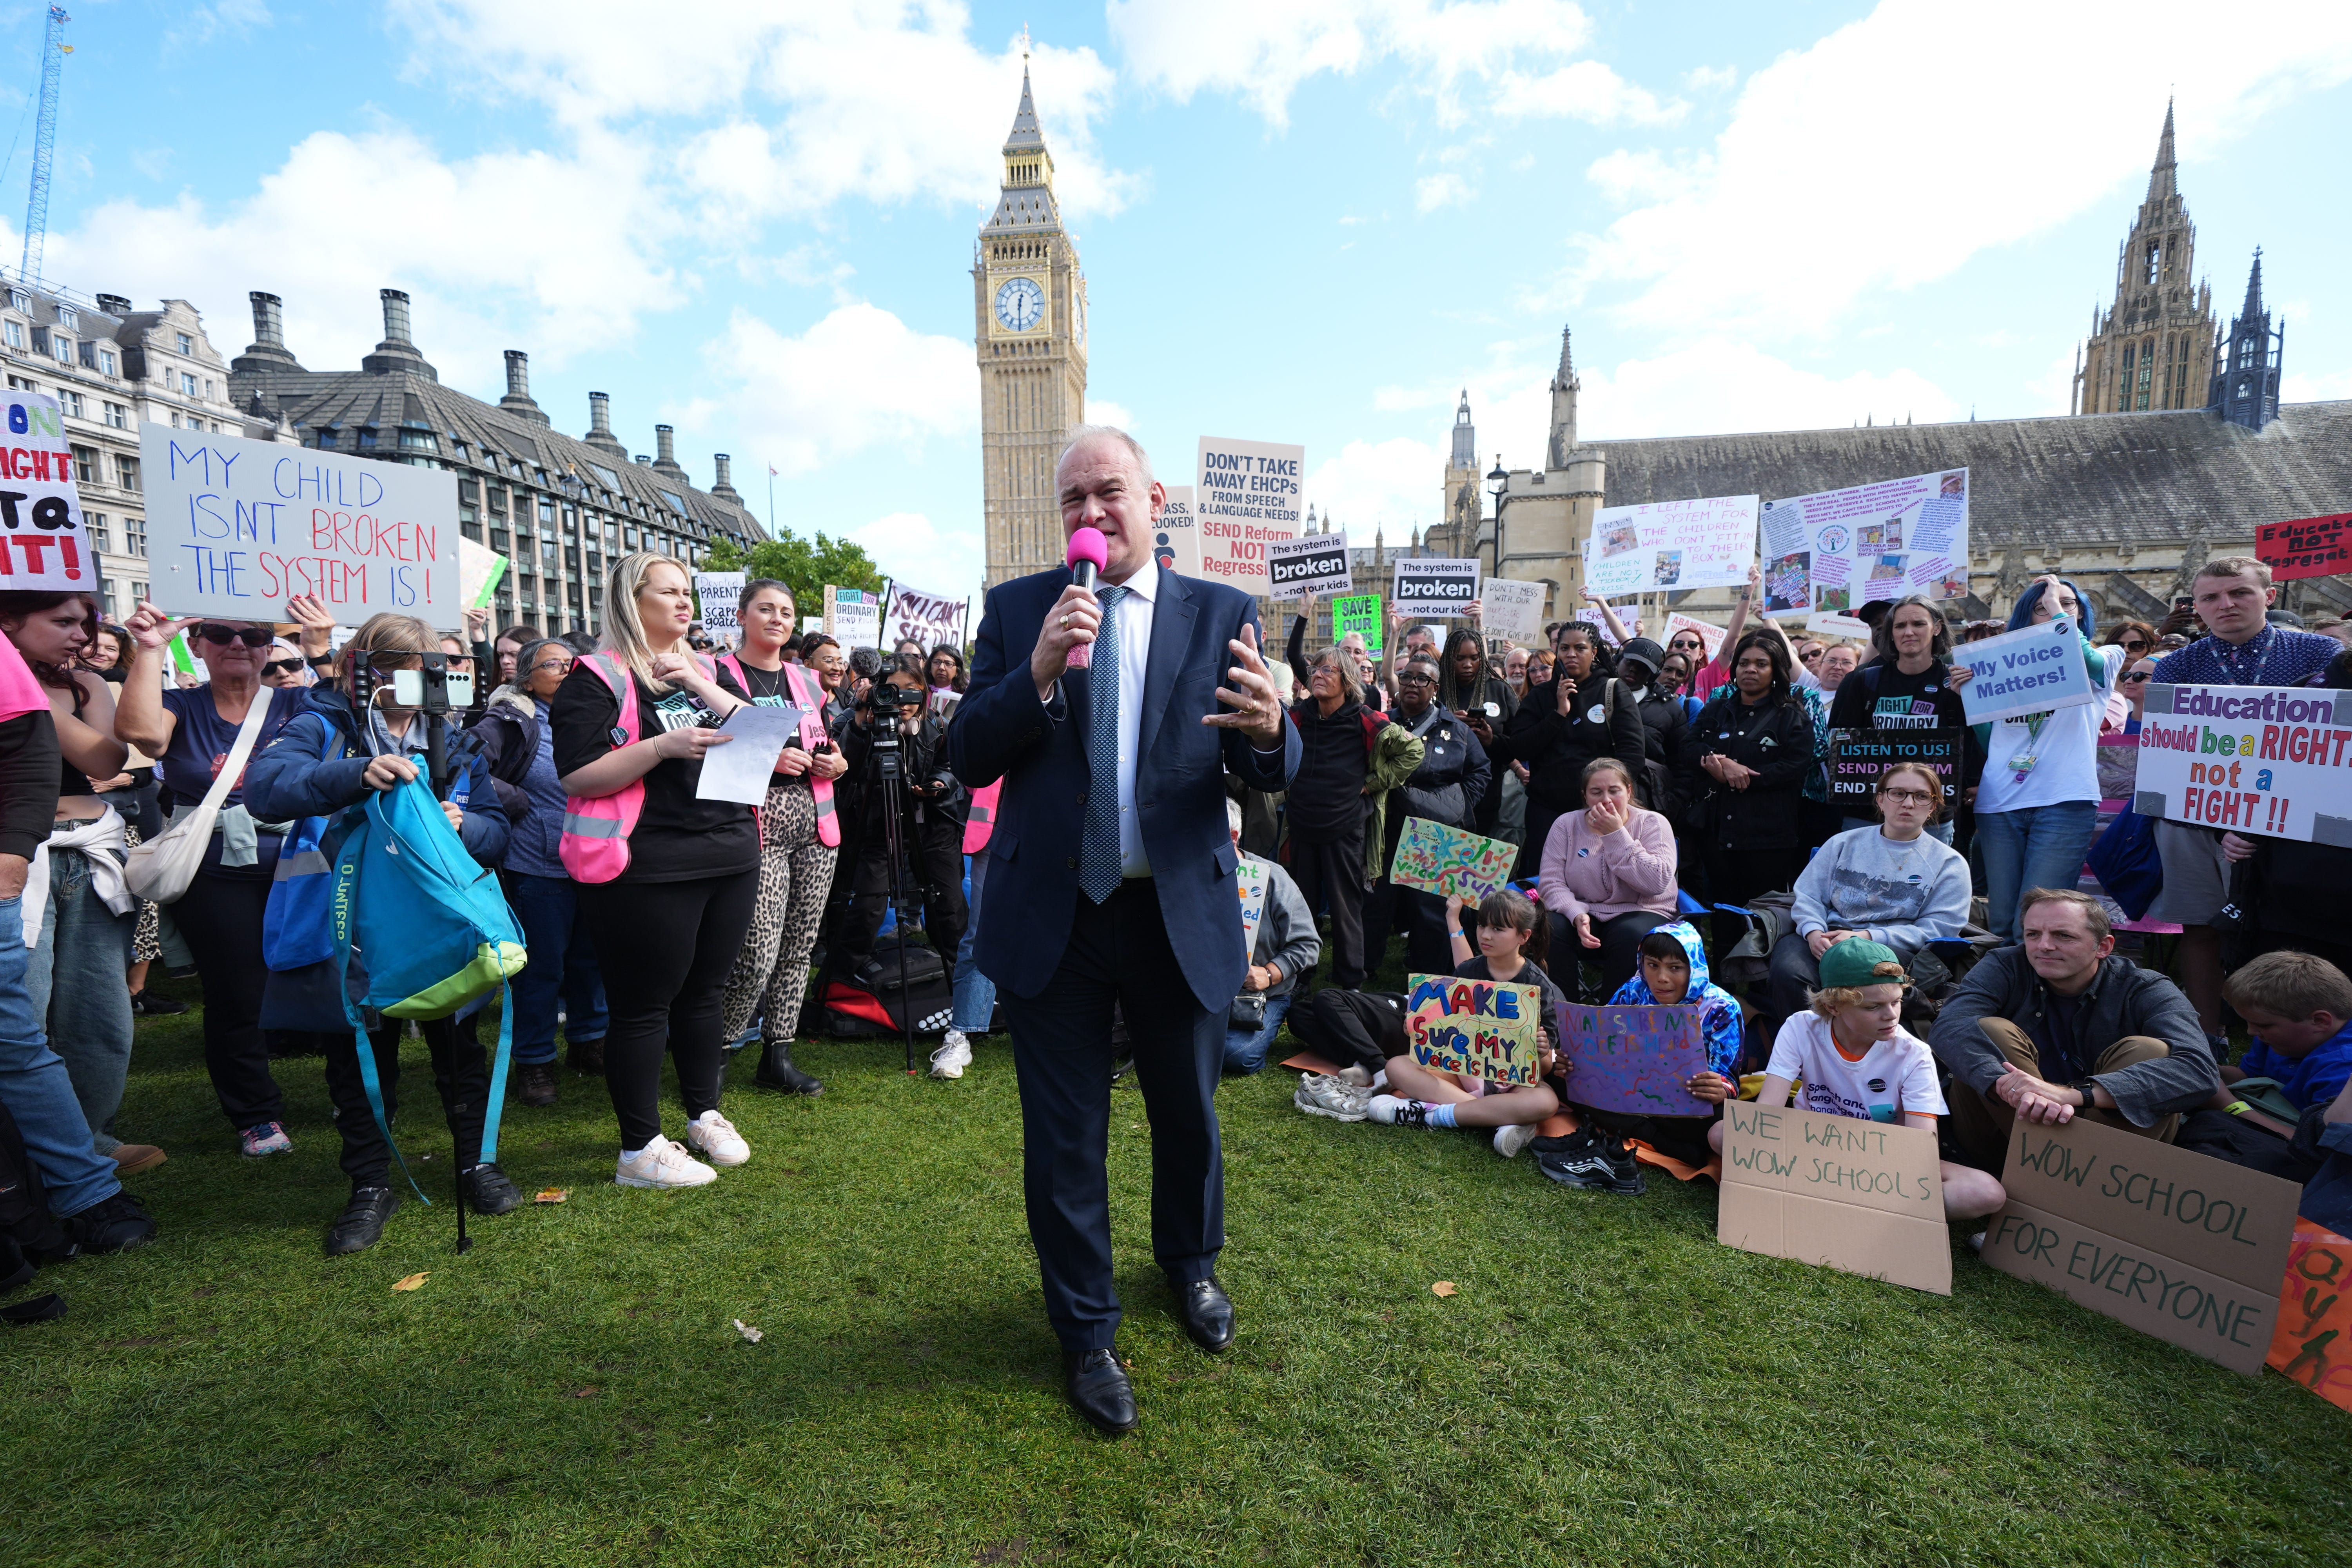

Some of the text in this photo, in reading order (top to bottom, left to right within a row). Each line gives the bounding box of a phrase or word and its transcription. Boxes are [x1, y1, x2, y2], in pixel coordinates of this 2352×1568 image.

[170, 439, 383, 507] MY CHILD
[1206, 452, 1297, 476] DON'T TAKE
[1203, 472, 1298, 494] AWAY EHCPs
[1212, 491, 1285, 507] FROM SPEECH
[1657, 501, 1694, 512] LEFT
[1200, 503, 1299, 521] & LANGUAGE NEEDS!
[1722, 510, 1748, 519] FOR
[312, 508, 436, 562] BROKEN
[1203, 522, 1292, 541] SEND Reform
[1642, 522, 1740, 537] THE CHILDREN
[1272, 537, 1340, 554] The system is
[1642, 539, 1664, 547] WHO
[1710, 542, 1748, 552] THEIR
[1593, 560, 1640, 570] CHILDREN
[1692, 554, 1713, 563] BOX
[2262, 548, 2352, 568] Segregat
[180, 545, 250, 597] THE
[260, 552, 367, 603] SYSTEM
[1274, 557, 1343, 581] broken
[1424, 564, 1461, 574] system
[1464, 563, 1472, 572] is
[1308, 584, 1325, 592] our
[1327, 580, 1348, 590] kids
[1401, 579, 1471, 597] broken
[1490, 583, 1539, 597] DON'T MESS
[839, 591, 875, 604] FIGHT FOR
[889, 585, 929, 621] YOU
[1495, 594, 1512, 603] WITH
[837, 604, 876, 617] ORDINARY
[1342, 599, 1372, 617] SAVE
[1486, 605, 1521, 618] autistic
[1343, 617, 1372, 632] OUR
[1489, 616, 1518, 629] justice
[1672, 616, 1724, 639] ABANDONED
[1508, 630, 1521, 640] GIVE
[1969, 646, 2064, 677] My Voice
[1976, 666, 2066, 699] Matters!
[1877, 698, 1931, 713] FIGHT FOR
[2172, 687, 2333, 724] Education
[1841, 744, 1950, 755] LISTEN TO US!
[2141, 724, 2352, 769] should be a RIGHT
[1838, 763, 1878, 774] SEND
[2190, 760, 2273, 792] not a
[1835, 782, 1866, 793] END
[2183, 786, 2261, 828] FIGHT
[1410, 982, 1519, 1019] MAKE
[1613, 1010, 1658, 1034] SURE
[1413, 1016, 1516, 1063] Sure MY
[1568, 1034, 1617, 1055] VOICE
[1624, 1034, 1639, 1053] IS
[1414, 1044, 1461, 1072] Voice
[1465, 1054, 1481, 1076] is
[1730, 1105, 1887, 1156] WE WANT
[1732, 1145, 1932, 1201] WOW SCHOOLS
[2020, 1131, 2258, 1247] WOW SCHOOL
[1994, 1214, 2061, 1268] FOR
[2067, 1240, 2262, 1348] EVERYONE
